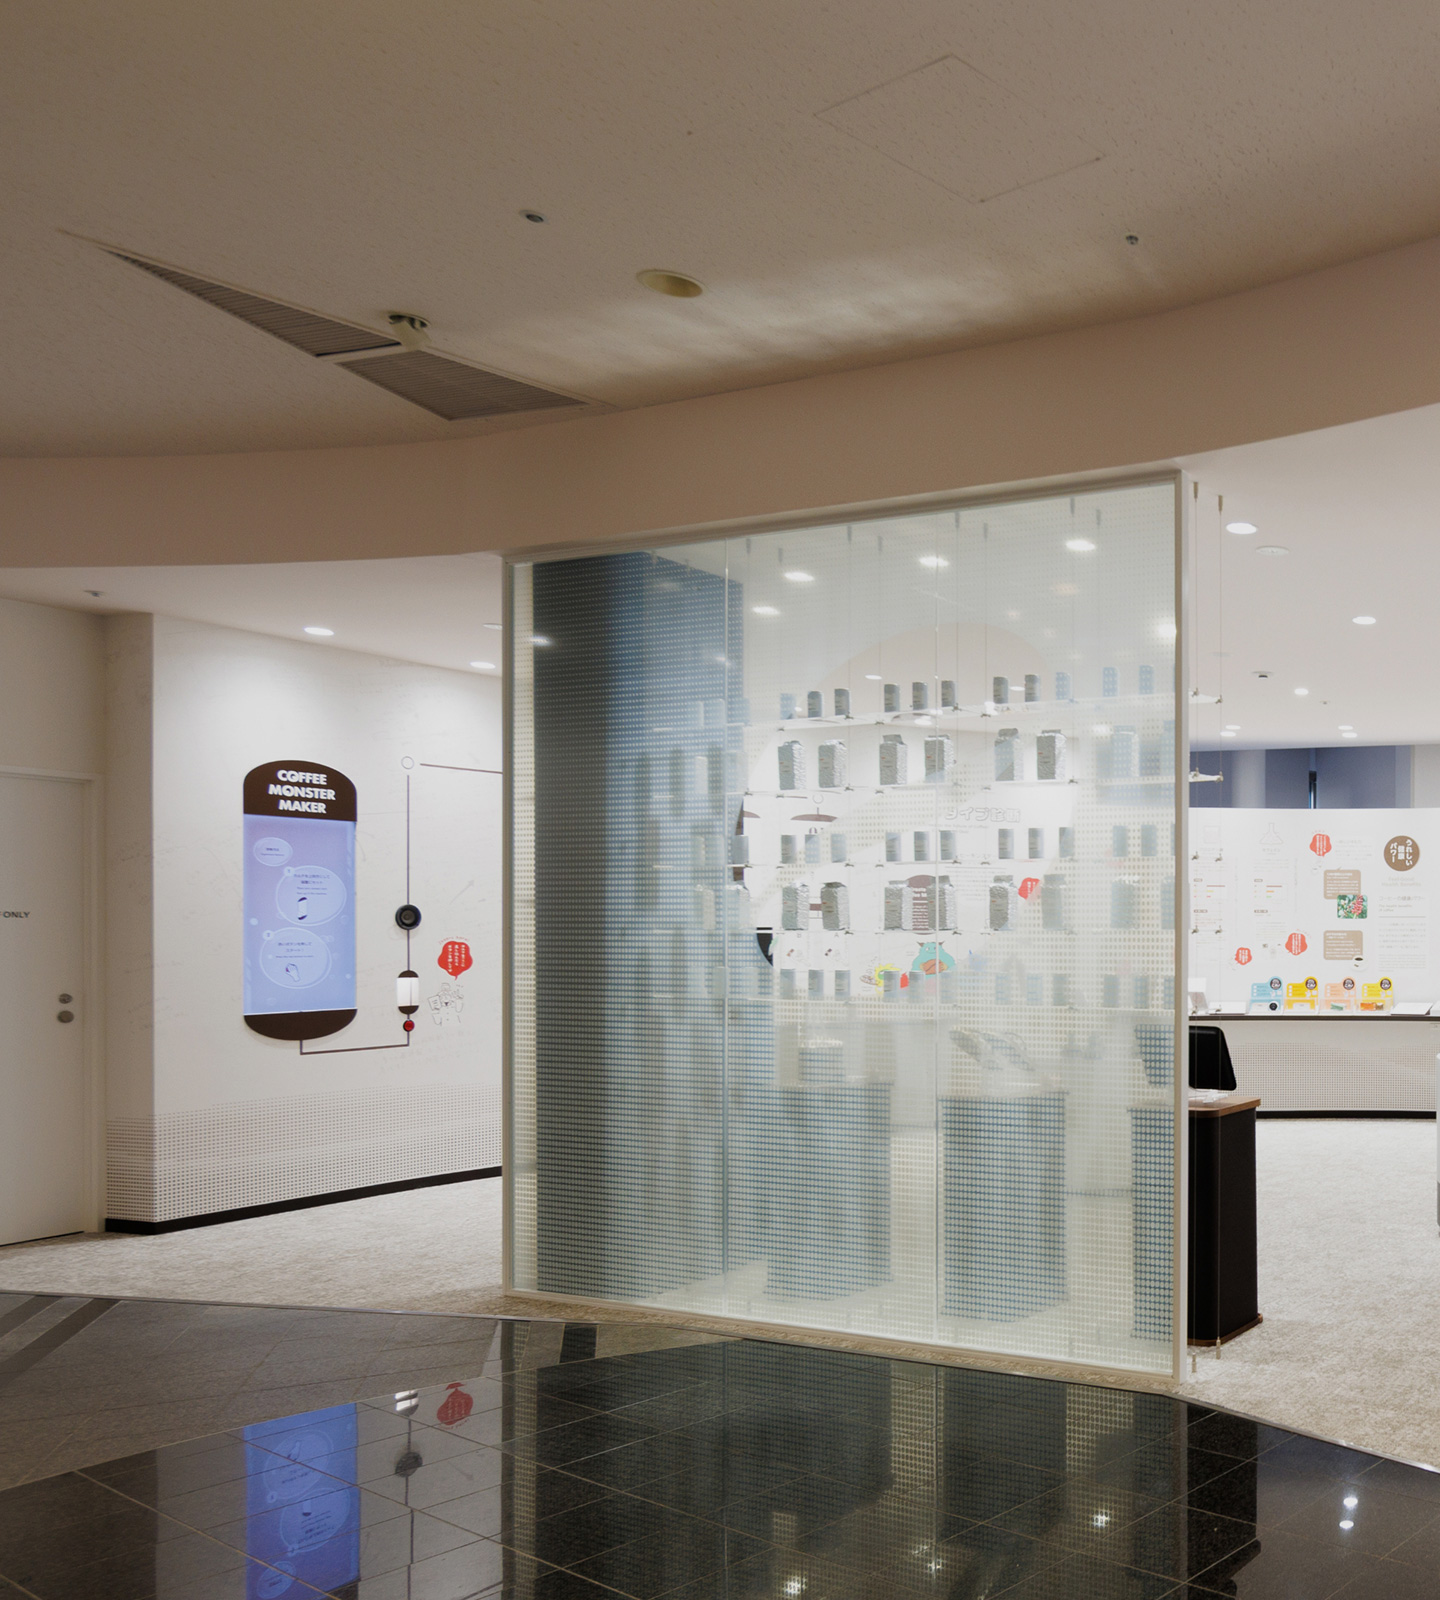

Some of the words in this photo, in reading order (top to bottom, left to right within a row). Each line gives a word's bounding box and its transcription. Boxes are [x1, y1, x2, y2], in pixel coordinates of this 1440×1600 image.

[277, 769, 327, 785] COFFEE
[268, 784, 336, 800] MONSTER
[278, 799, 327, 814] MAKER
[1390, 842, 1398, 863] パワー
